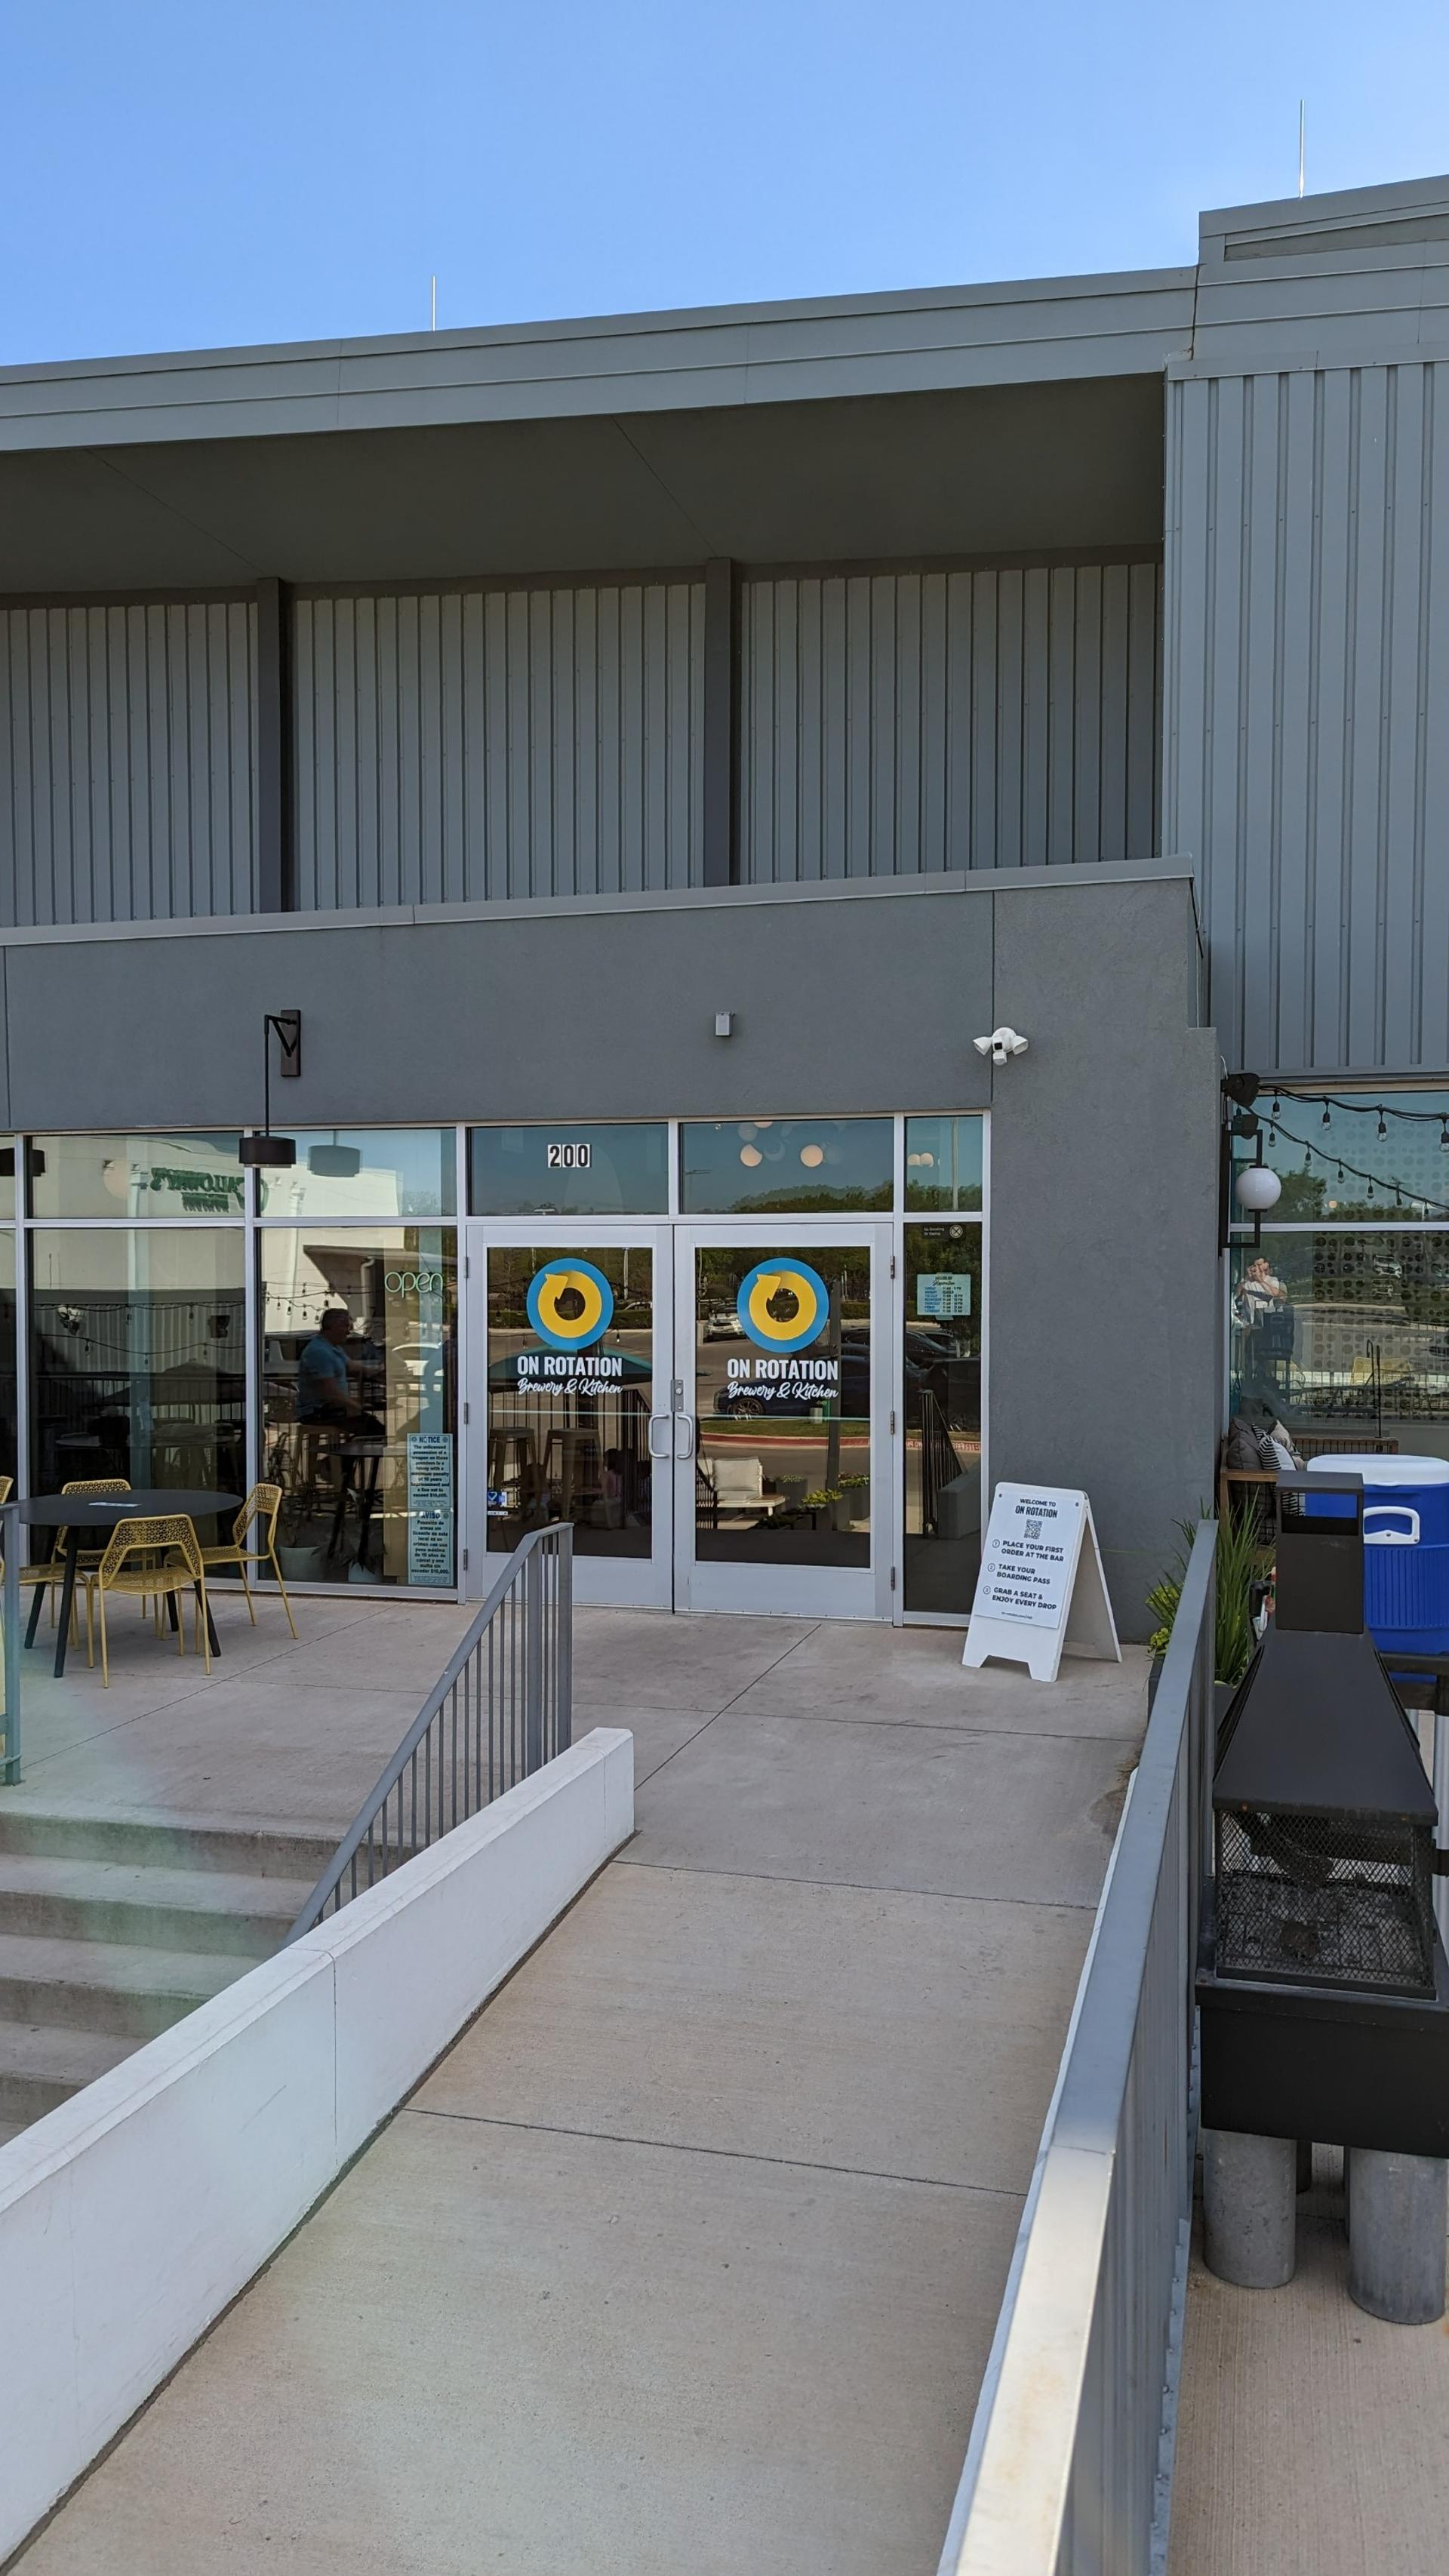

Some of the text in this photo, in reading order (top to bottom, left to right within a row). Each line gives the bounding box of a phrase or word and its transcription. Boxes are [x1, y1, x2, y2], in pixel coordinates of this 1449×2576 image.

[549, 1145, 588, 1167] 200
[385, 1271, 443, 1298] open
[517, 1356, 623, 1377] ON ROTATION
[727, 1359, 838, 1380] ON ROTATION
[517, 1377, 623, 1396] Brewery & Kitchen
[727, 1381, 839, 1400] Brewery & Kitchen
[1020, 1498, 1048, 1507] WELCOME
[1015, 1505, 1058, 1518] ON ROTATION
[1001, 1548, 1024, 1556] ORDER
[1026, 1543, 1044, 1551] YOUR
[1044, 1545, 1063, 1553] FIRST
[996, 1571, 1032, 1582] BOARDING
[1017, 1566, 1035, 1574] YOUR
[994, 1587, 1012, 1595] GRAB
[992, 1595, 1013, 1603] ENJOY
[1015, 1599, 1037, 1608] EVERY
